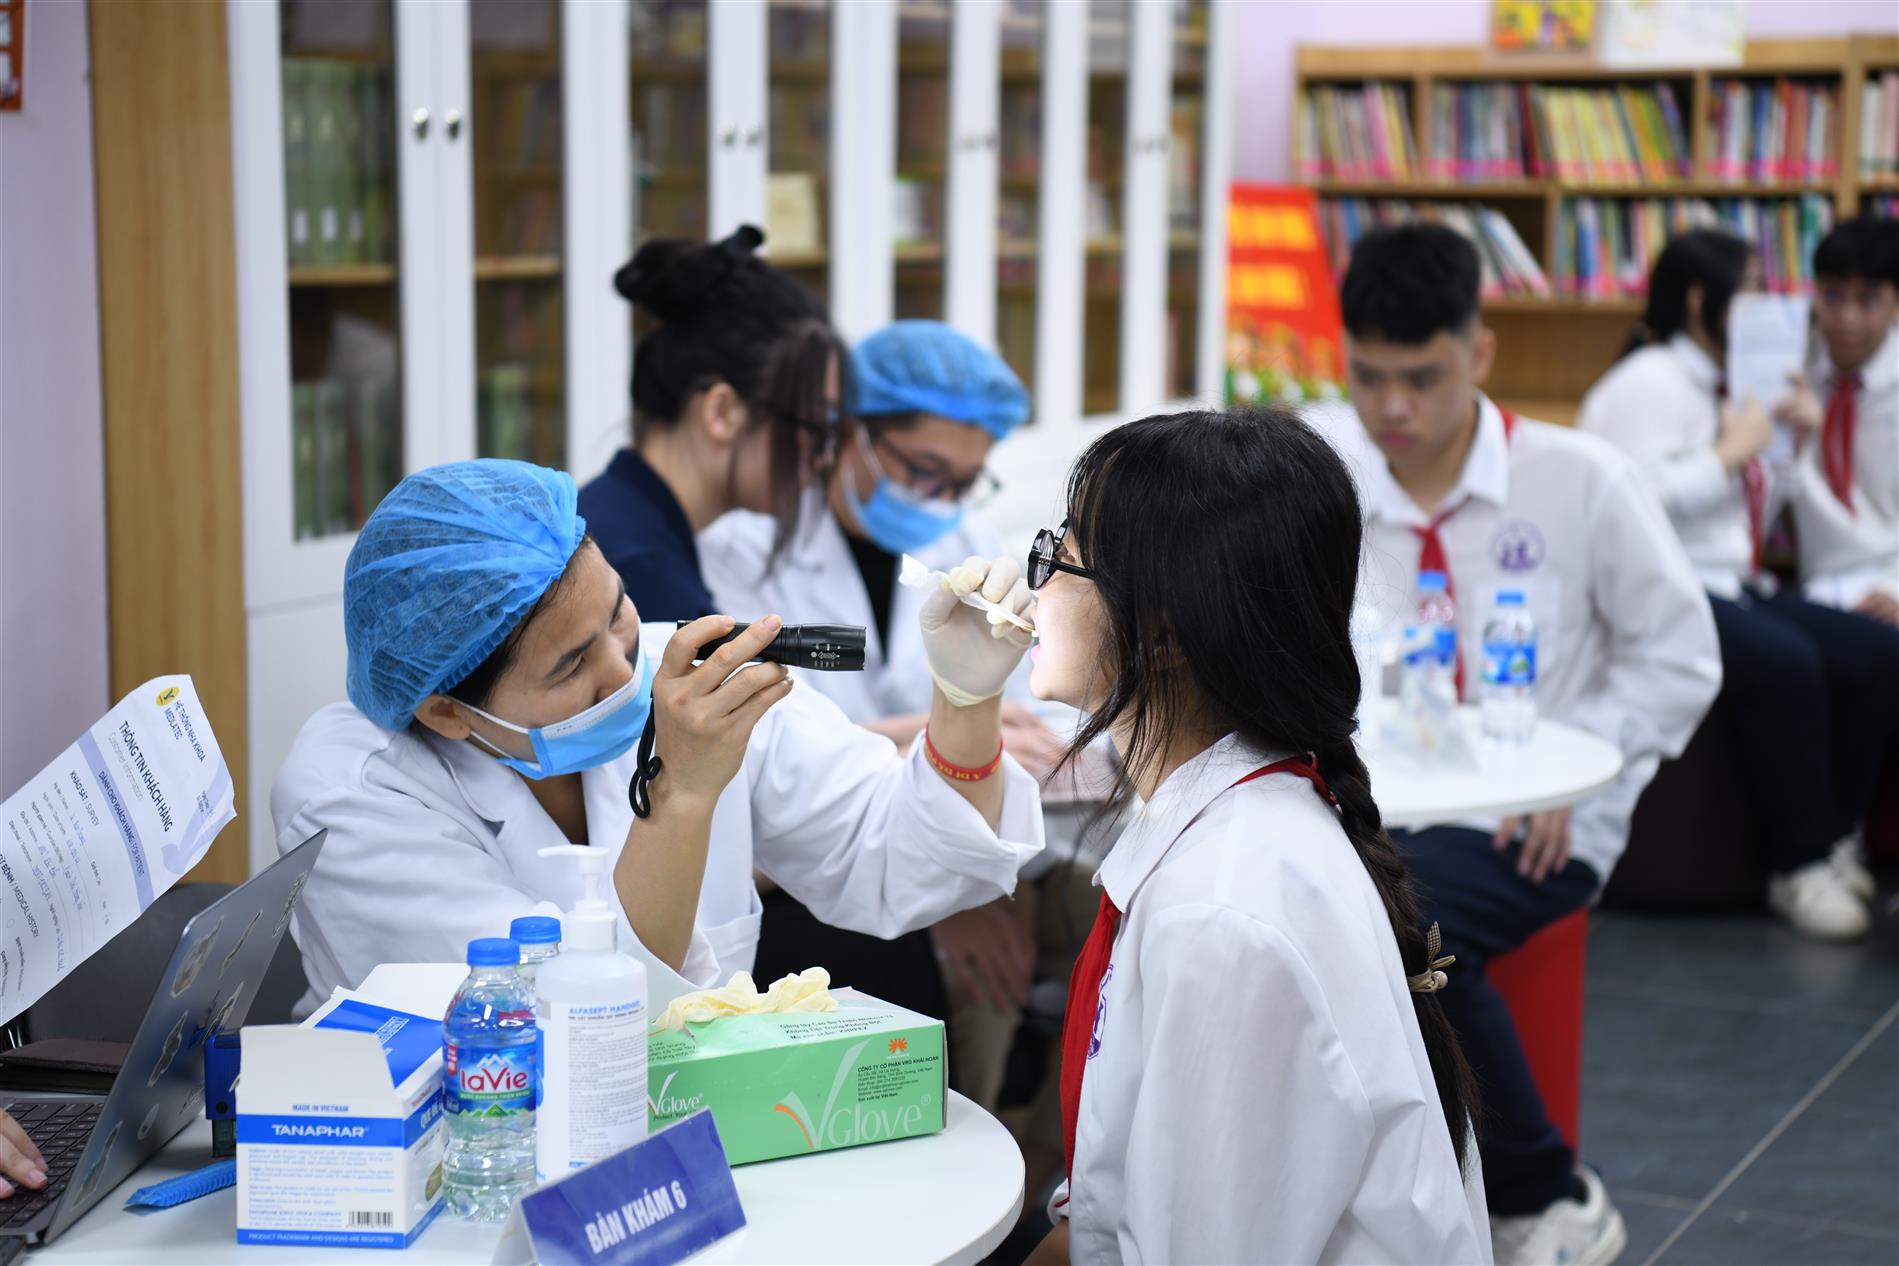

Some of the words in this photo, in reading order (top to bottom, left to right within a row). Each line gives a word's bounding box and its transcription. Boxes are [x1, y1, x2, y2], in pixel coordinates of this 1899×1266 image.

[163, 707, 183, 740] MEDLATEC
[192, 741, 205, 762] KHOA
[106, 789, 117, 805] CHO
[133, 752, 147, 773] TIN
[141, 769, 164, 805] KHÁCH
[157, 803, 173, 832] HÀNG
[84, 803, 100, 826] SURVEY
[12, 886, 29, 915] MEDICAL
[25, 913, 39, 937] HISTORY
[568, 1007, 607, 1015] ALFASEPT
[292, 1104, 310, 1112] MADE
[312, 1104, 319, 1112] IN
[320, 1105, 349, 1113] VIETNAM
[272, 1124, 365, 1138] TANAPHAR
[584, 1211, 627, 1255] BÀN
[622, 1187, 675, 1235] KHÁM
[671, 1180, 687, 1209] 6
[248, 1232, 276, 1240] PRODUCT
